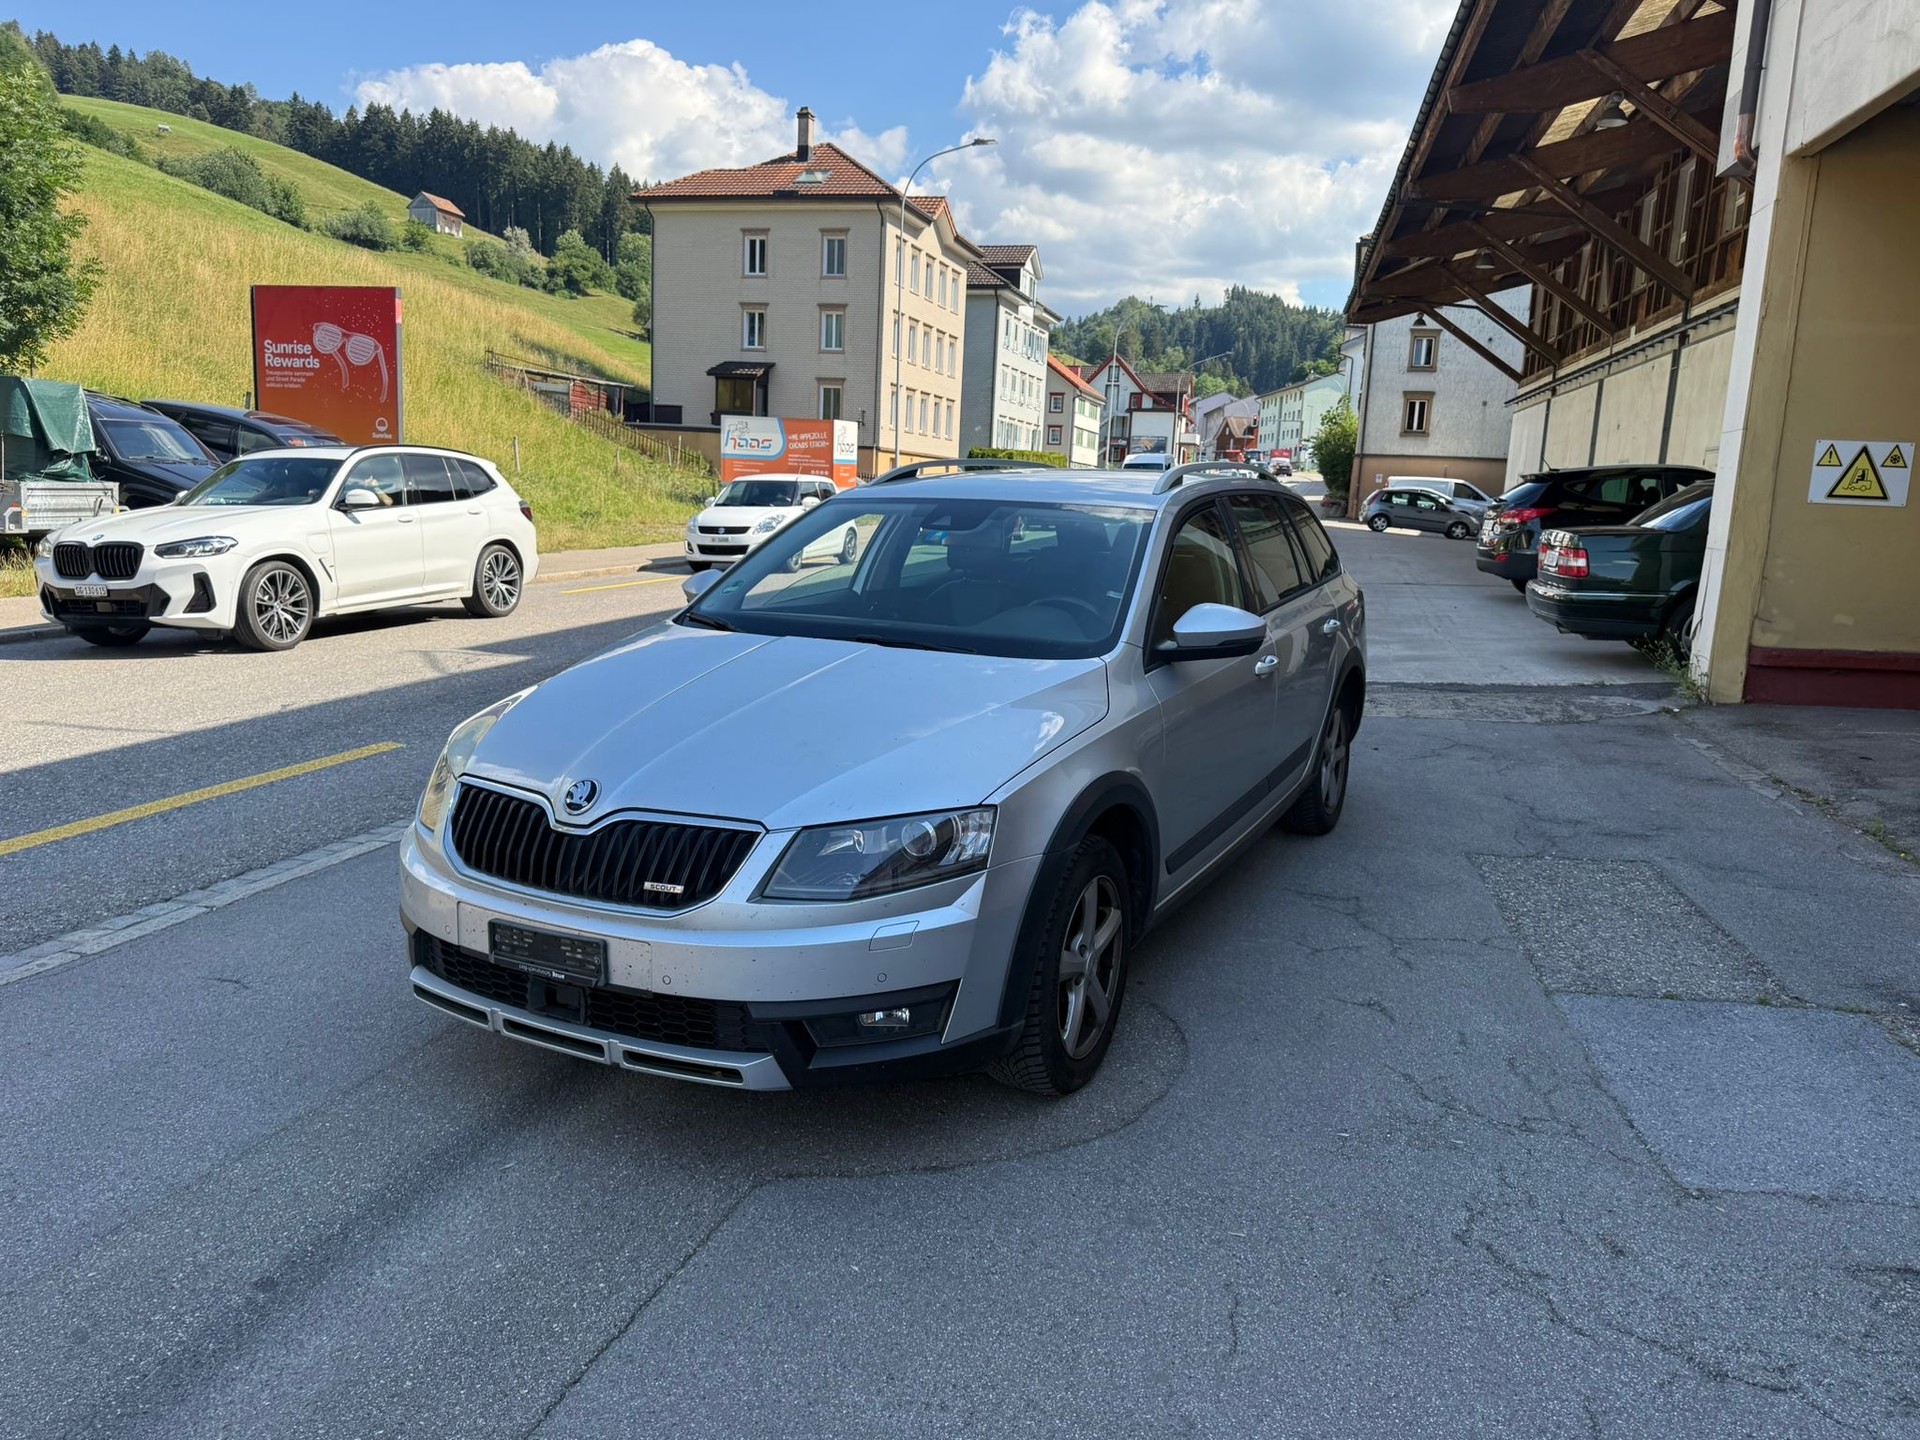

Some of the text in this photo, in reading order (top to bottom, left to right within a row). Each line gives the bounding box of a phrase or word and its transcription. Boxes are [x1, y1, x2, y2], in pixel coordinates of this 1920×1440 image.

[264, 340, 312, 354] Sunrise
[265, 353, 320, 368] Rewards
[725, 429, 773, 450] haas
[650, 884, 677, 892] SCOUT
